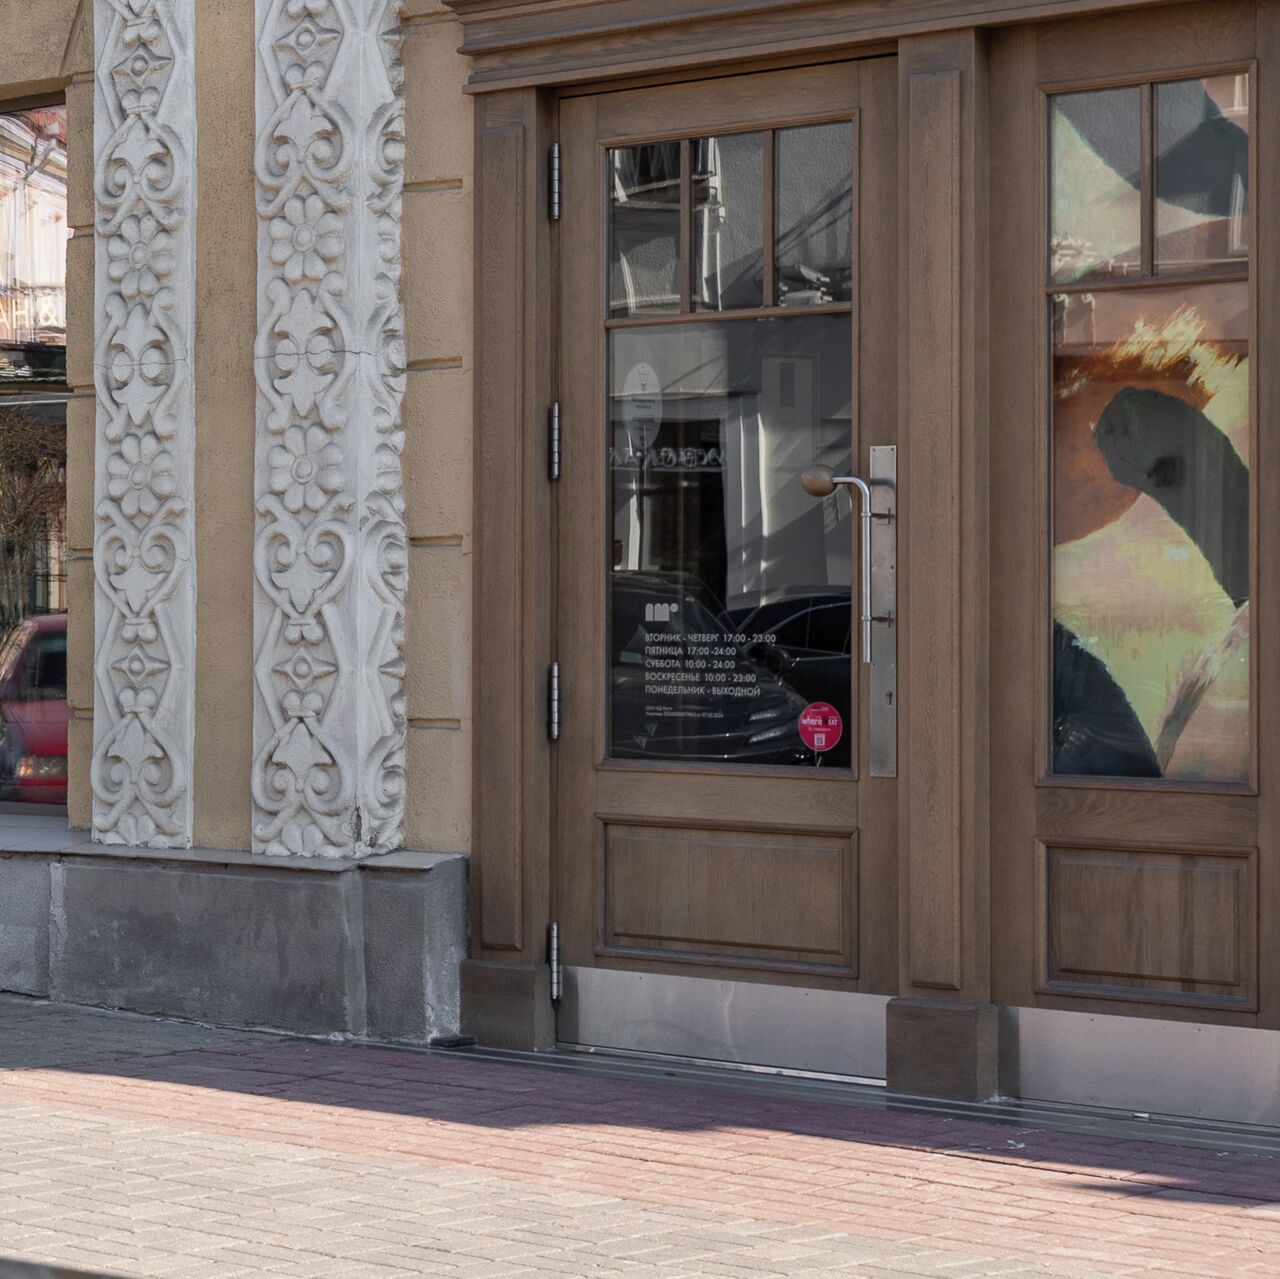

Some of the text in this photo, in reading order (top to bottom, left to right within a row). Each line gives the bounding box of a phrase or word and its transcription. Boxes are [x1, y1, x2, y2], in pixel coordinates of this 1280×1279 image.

[39, 302, 59, 326] &
[645, 647, 683, 655] ПЯТНИЦА
[645, 673, 700, 681] ВОСКРЕСЕНЬЕ
[645, 686, 705, 695] ПОНЕДЕЛЬНИК
[712, 686, 760, 696] ВЫХОДНОЙ
